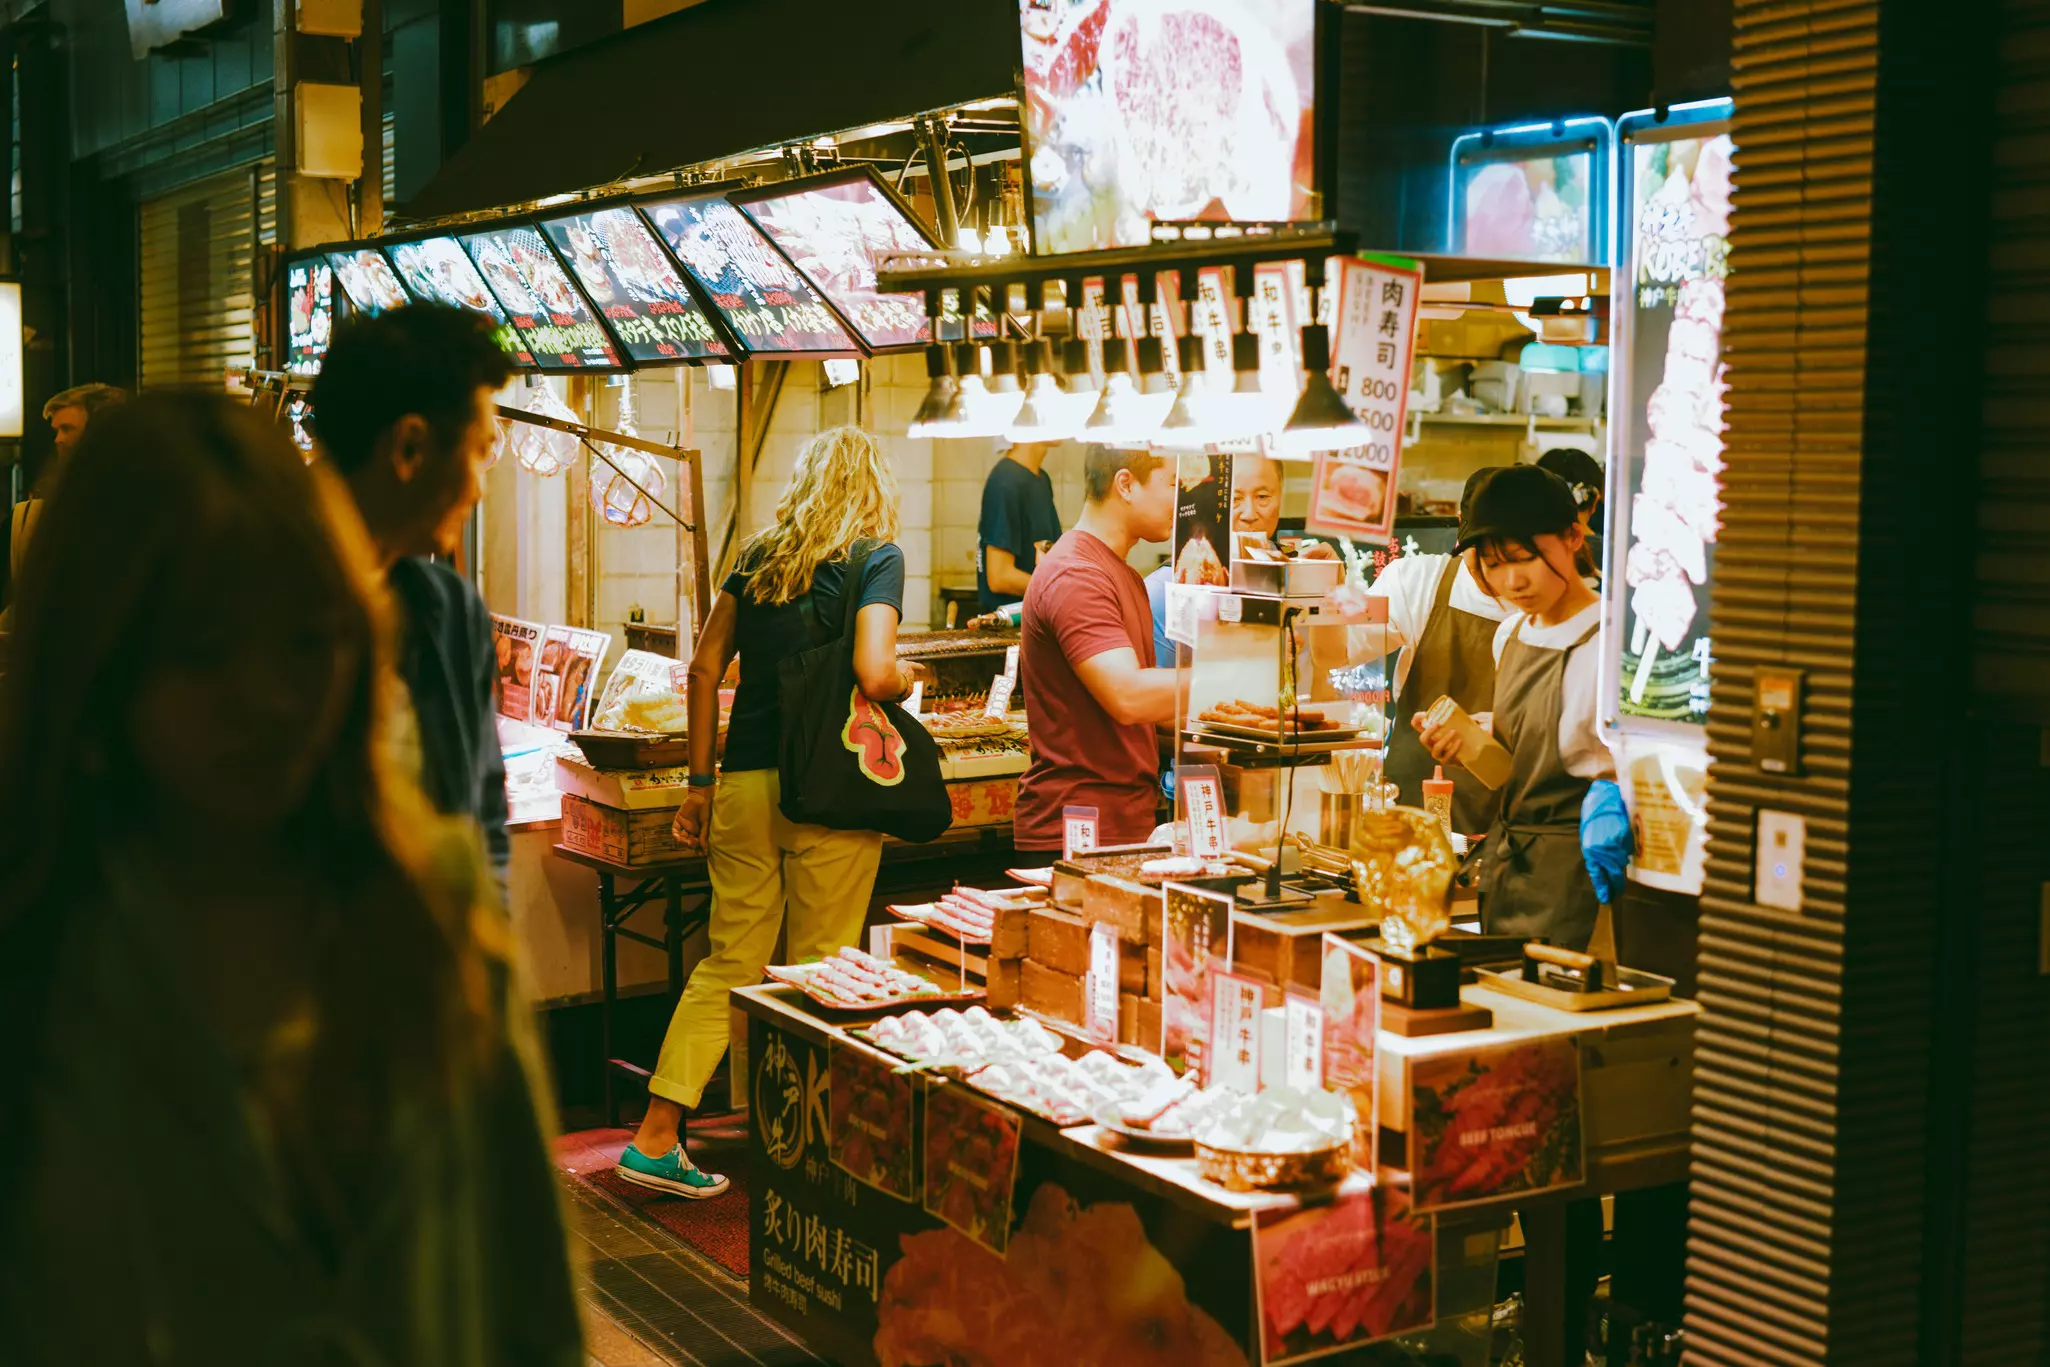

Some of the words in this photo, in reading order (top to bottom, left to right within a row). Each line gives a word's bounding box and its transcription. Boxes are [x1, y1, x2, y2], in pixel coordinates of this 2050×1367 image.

[1376, 278, 1404, 370] 肉寿司
[1351, 408, 1395, 432] 500
[1361, 377, 1398, 401] 800
[1200, 783, 1218, 851] 神戸牛串
[1489, 1121, 1537, 1141] TONGUE
[763, 1188, 878, 1302] 炙り肉寿司
[763, 1247, 793, 1281] Grilled
[793, 1265, 816, 1294] beef
[816, 1283, 842, 1312] sushi
